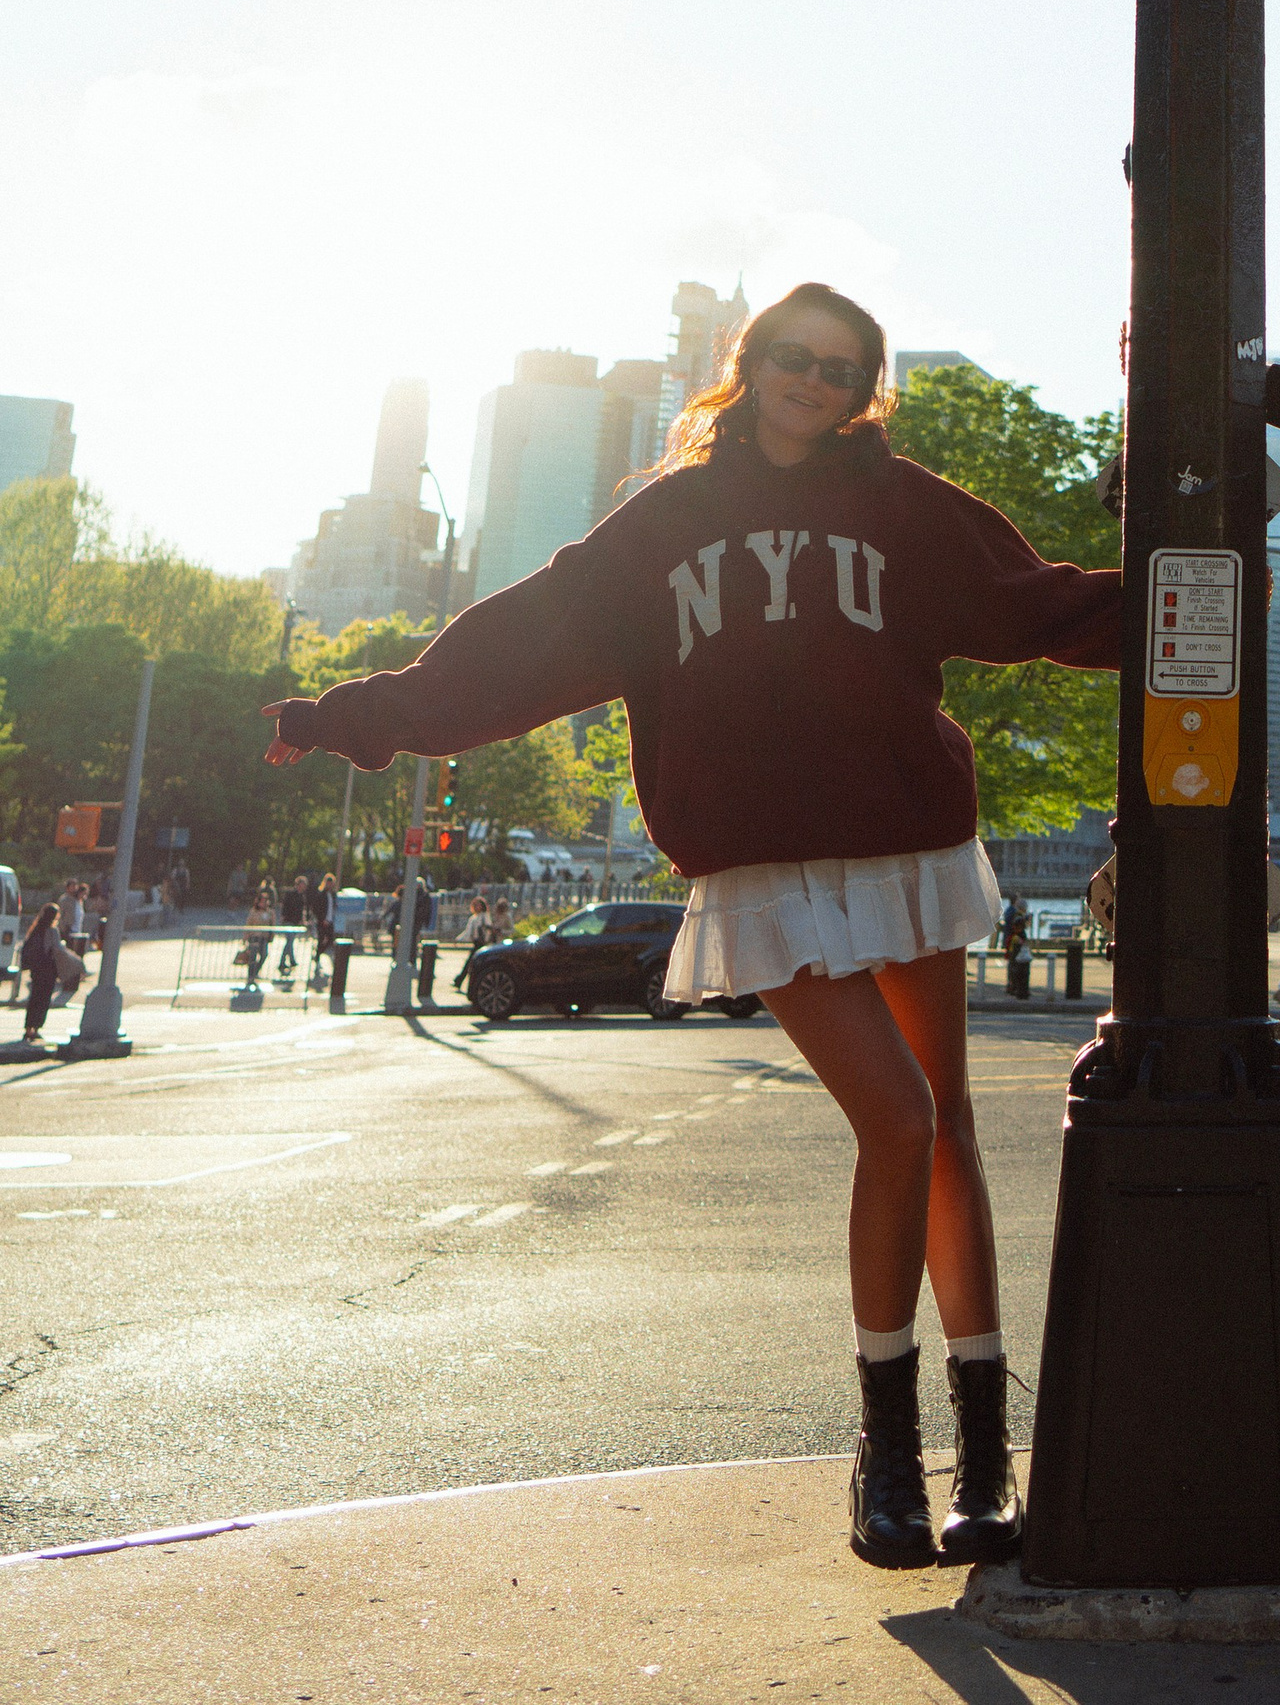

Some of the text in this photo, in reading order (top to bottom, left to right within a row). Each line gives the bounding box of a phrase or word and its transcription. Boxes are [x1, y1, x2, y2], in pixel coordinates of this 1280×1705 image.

[1185, 559, 1228, 568] START CROSSING
[1195, 576, 1215, 584] Vehicles
[1189, 587, 1224, 596] DON'T START
[1205, 597, 1225, 606] Crossing
[1200, 604, 1218, 612] Started
[1191, 623, 1206, 631] Finish
[1208, 624, 1229, 633] Crossing
[1185, 643, 1221, 652] DON'T CROSS
[1169, 665, 1216, 674] PUSH BUTTON
[1175, 678, 1208, 687] TO CROSS
